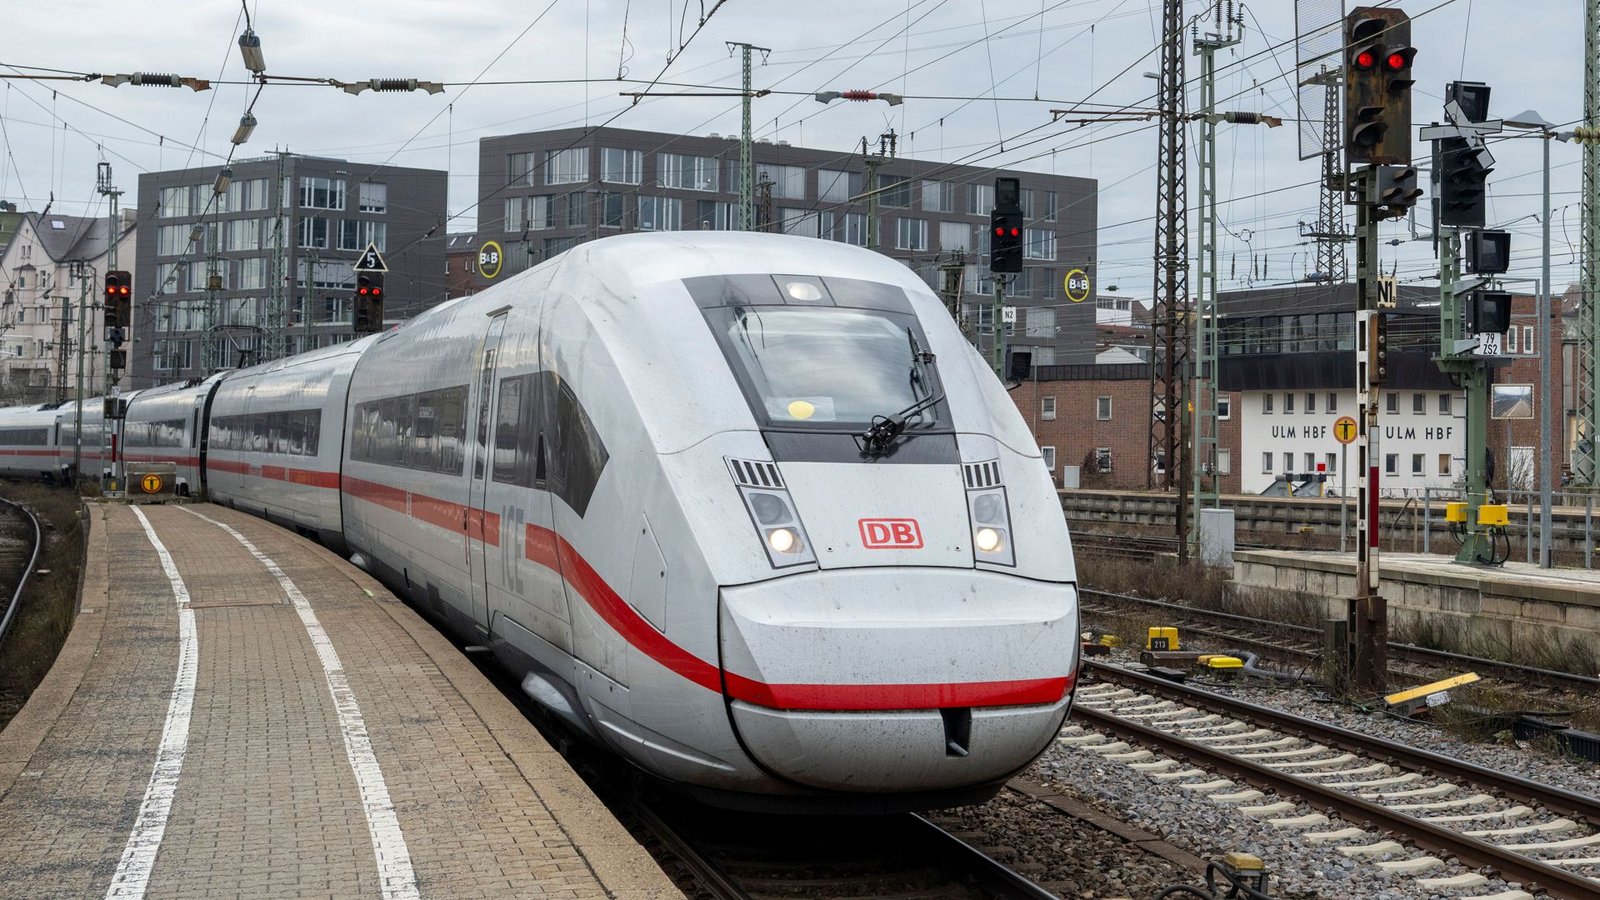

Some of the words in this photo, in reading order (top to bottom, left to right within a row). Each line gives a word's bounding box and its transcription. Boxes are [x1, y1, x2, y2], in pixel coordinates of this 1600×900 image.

[366, 251, 376, 268] 5
[480, 252, 498, 265] B&B
[1069, 278, 1088, 290] B&B
[1004, 310, 1014, 319] N2
[1485, 333, 1495, 344] 79
[1483, 343, 1498, 355] ZS2
[1271, 425, 1296, 439] ULM
[1303, 425, 1326, 439] HBF
[1385, 425, 1416, 440] ULM
[1425, 426, 1453, 440] HBF
[865, 522, 916, 545] DB
[501, 504, 525, 595] ICE
[1154, 640, 1166, 649] 213
